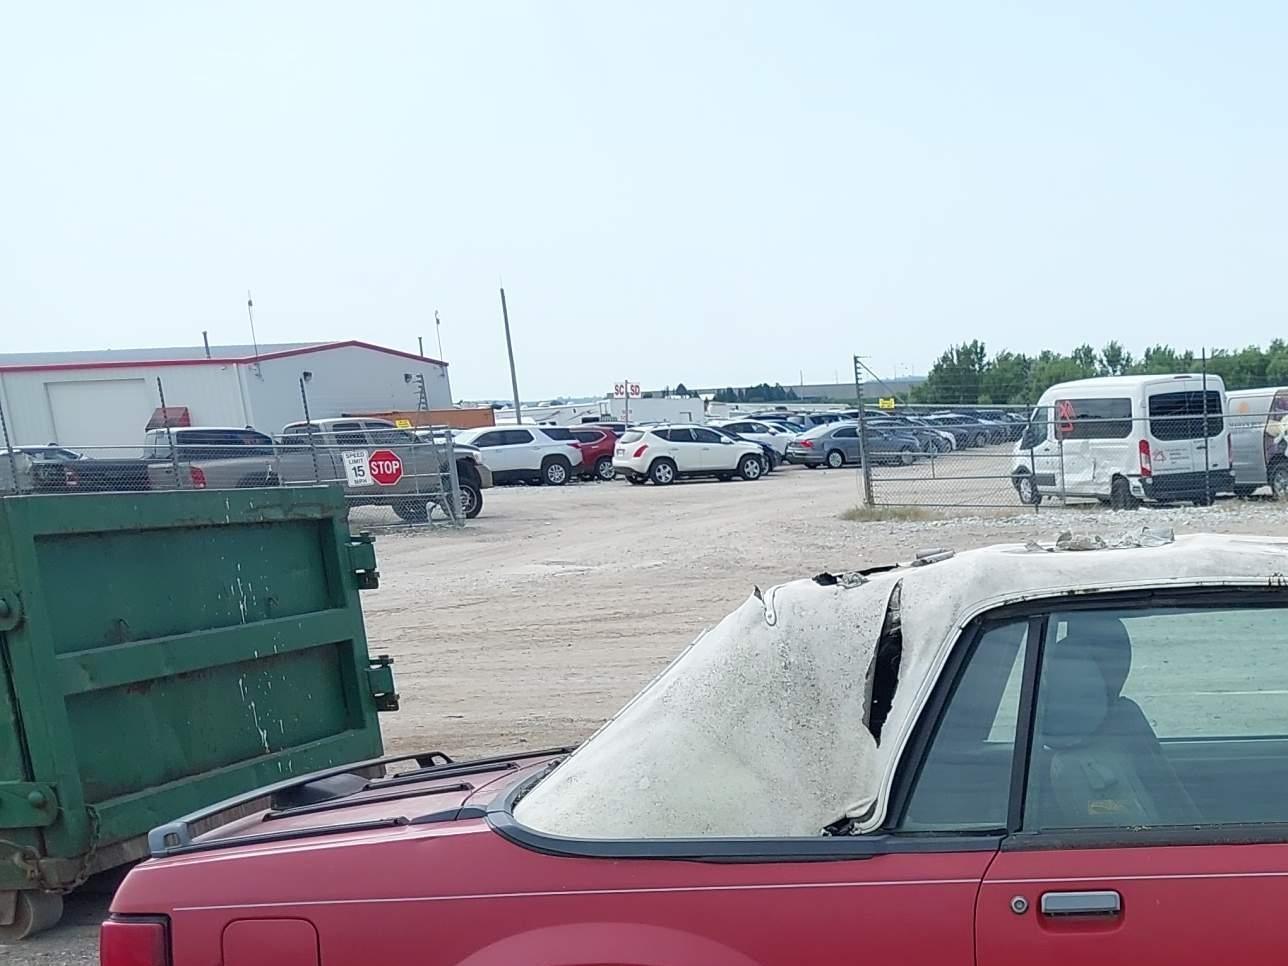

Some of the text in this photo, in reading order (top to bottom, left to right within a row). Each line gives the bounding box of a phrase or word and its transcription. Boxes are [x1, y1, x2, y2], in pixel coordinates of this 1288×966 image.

[614, 384, 625, 396] SC
[630, 384, 641, 396] SD
[352, 465, 365, 478] 15
[371, 460, 400, 475] STOP
